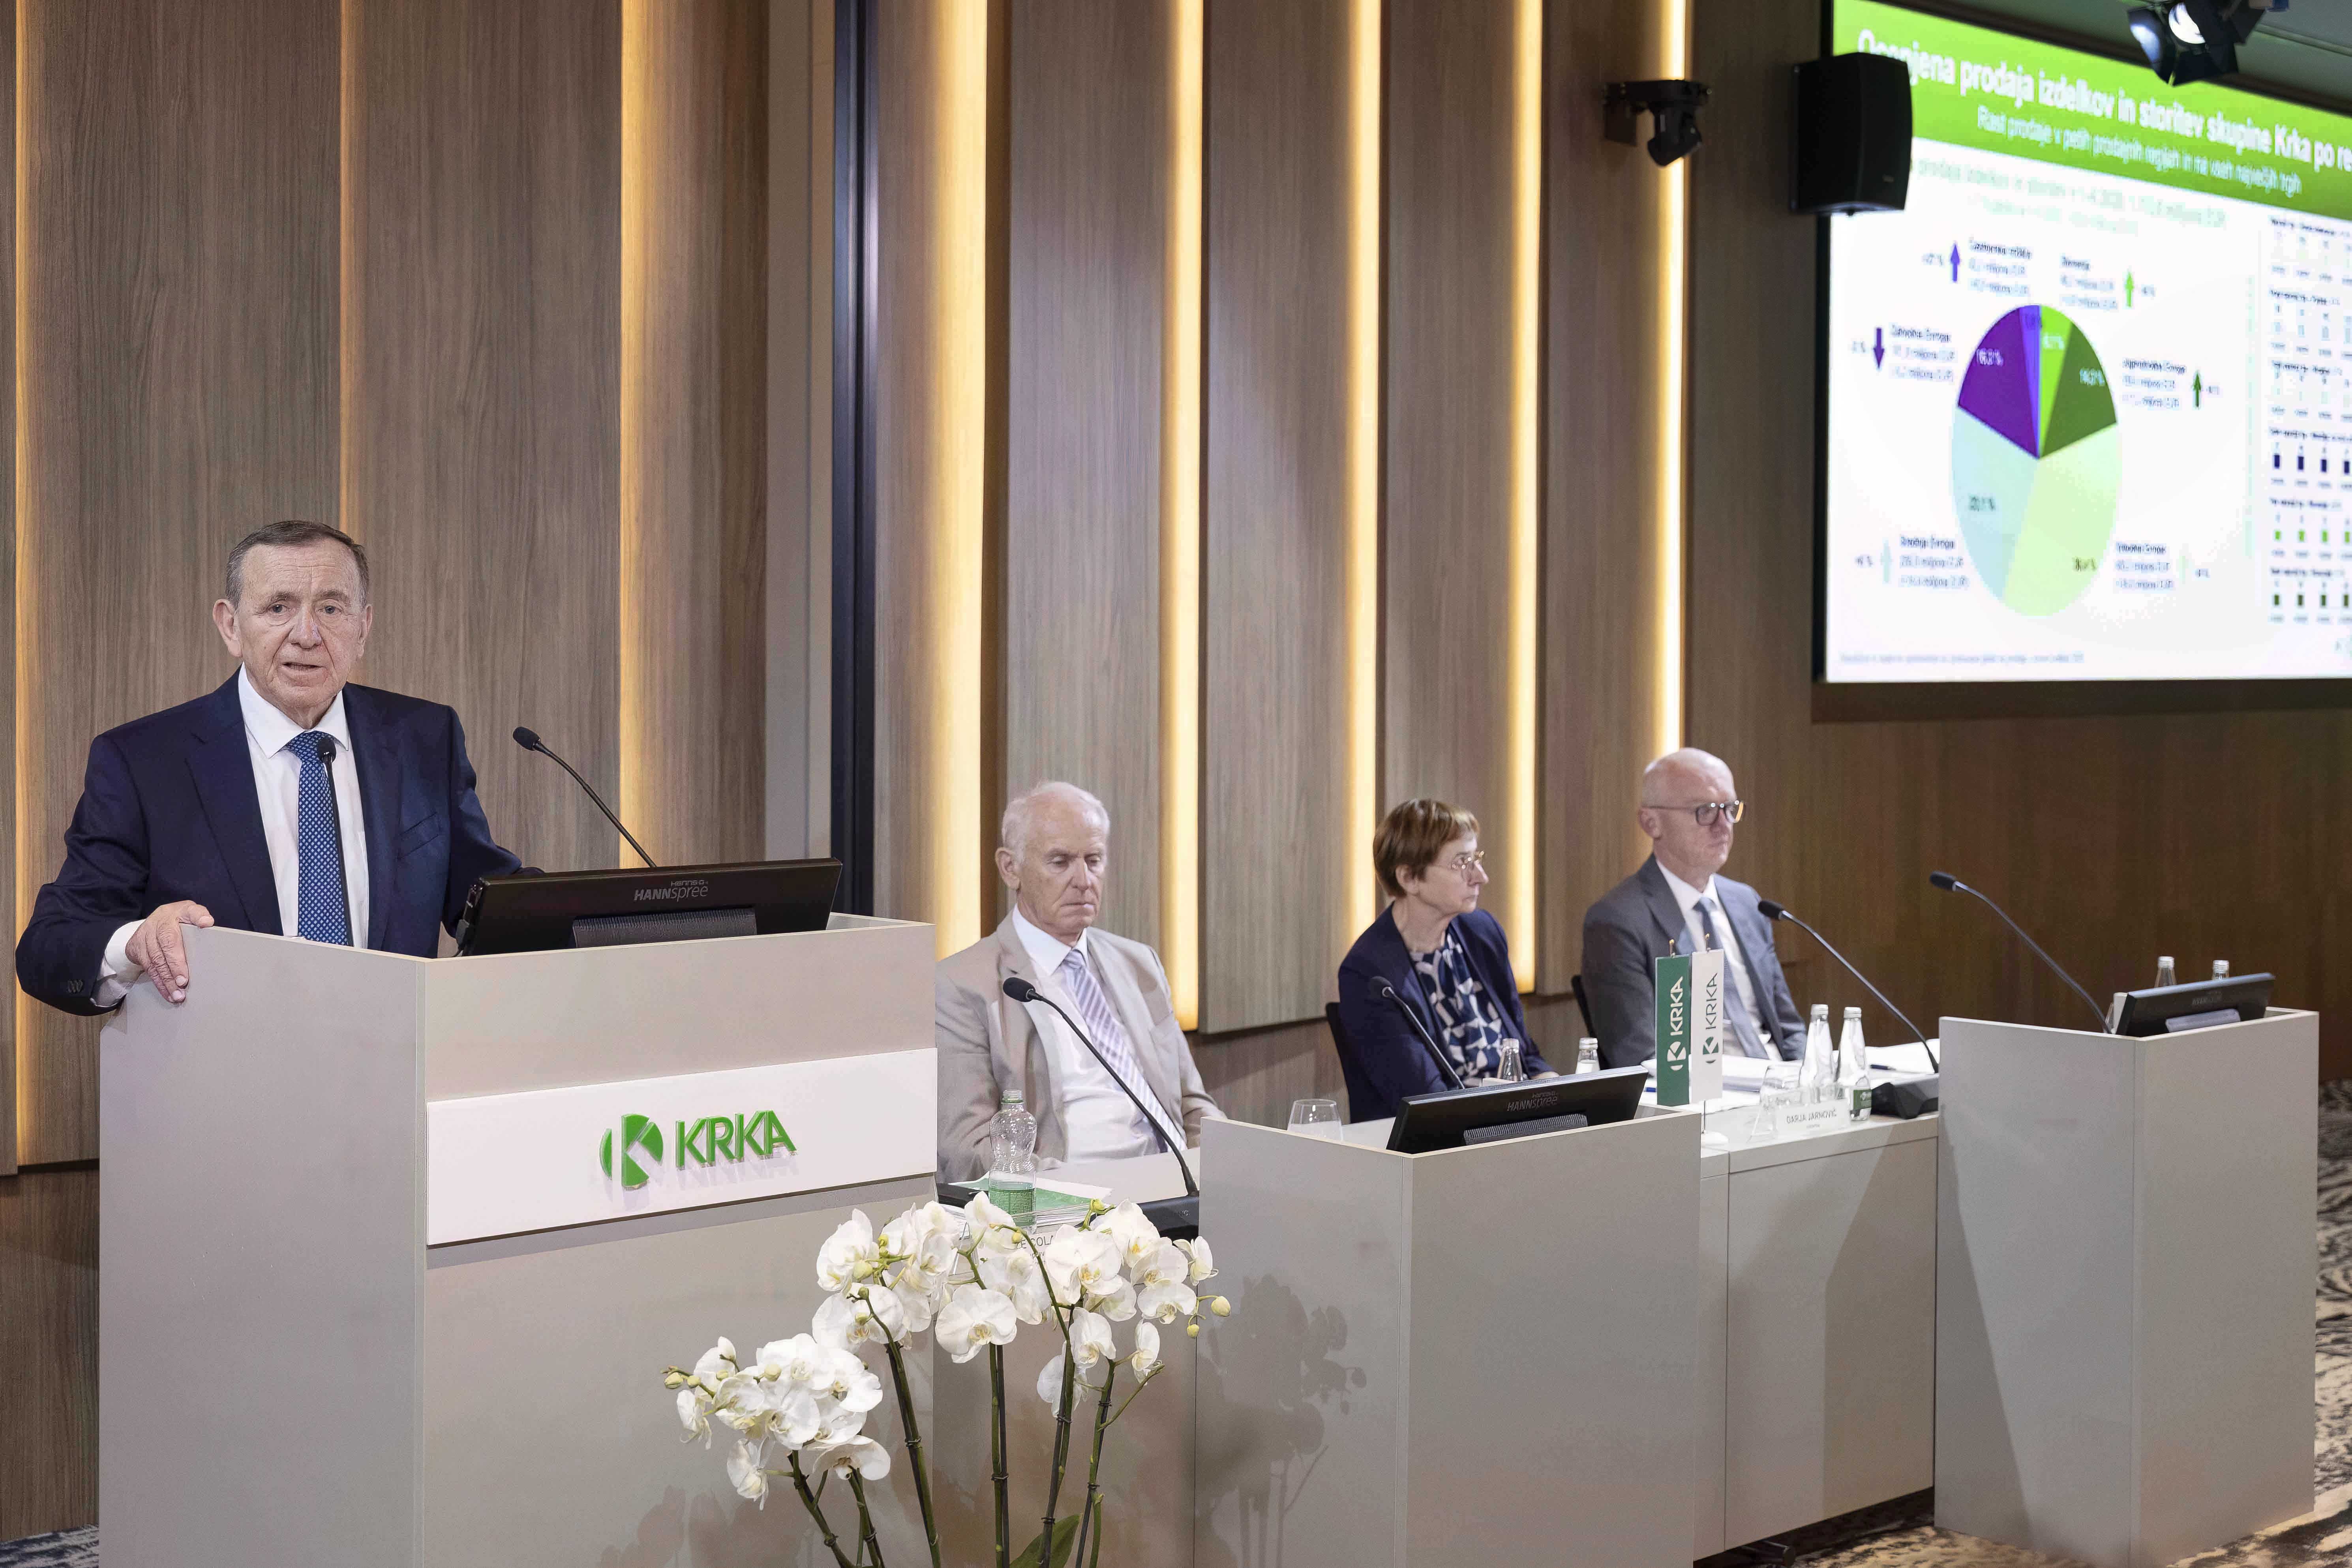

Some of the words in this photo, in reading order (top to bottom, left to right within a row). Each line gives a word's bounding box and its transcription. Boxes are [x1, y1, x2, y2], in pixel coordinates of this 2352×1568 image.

[1960, 60, 2034, 108] prodaja
[2039, 69, 2114, 119] izdelkov
[2118, 87, 2136, 124] in
[2139, 97, 2204, 138] storitev
[2207, 111, 2271, 155] skupine
[2274, 124, 2312, 163] Krka
[2314, 141, 2335, 173] po
[634, 885, 708, 903] HANNspree
[1670, 976, 1683, 1036] KRKA
[1705, 972, 1718, 1030] KRKA
[675, 1110, 797, 1171] KRKA
